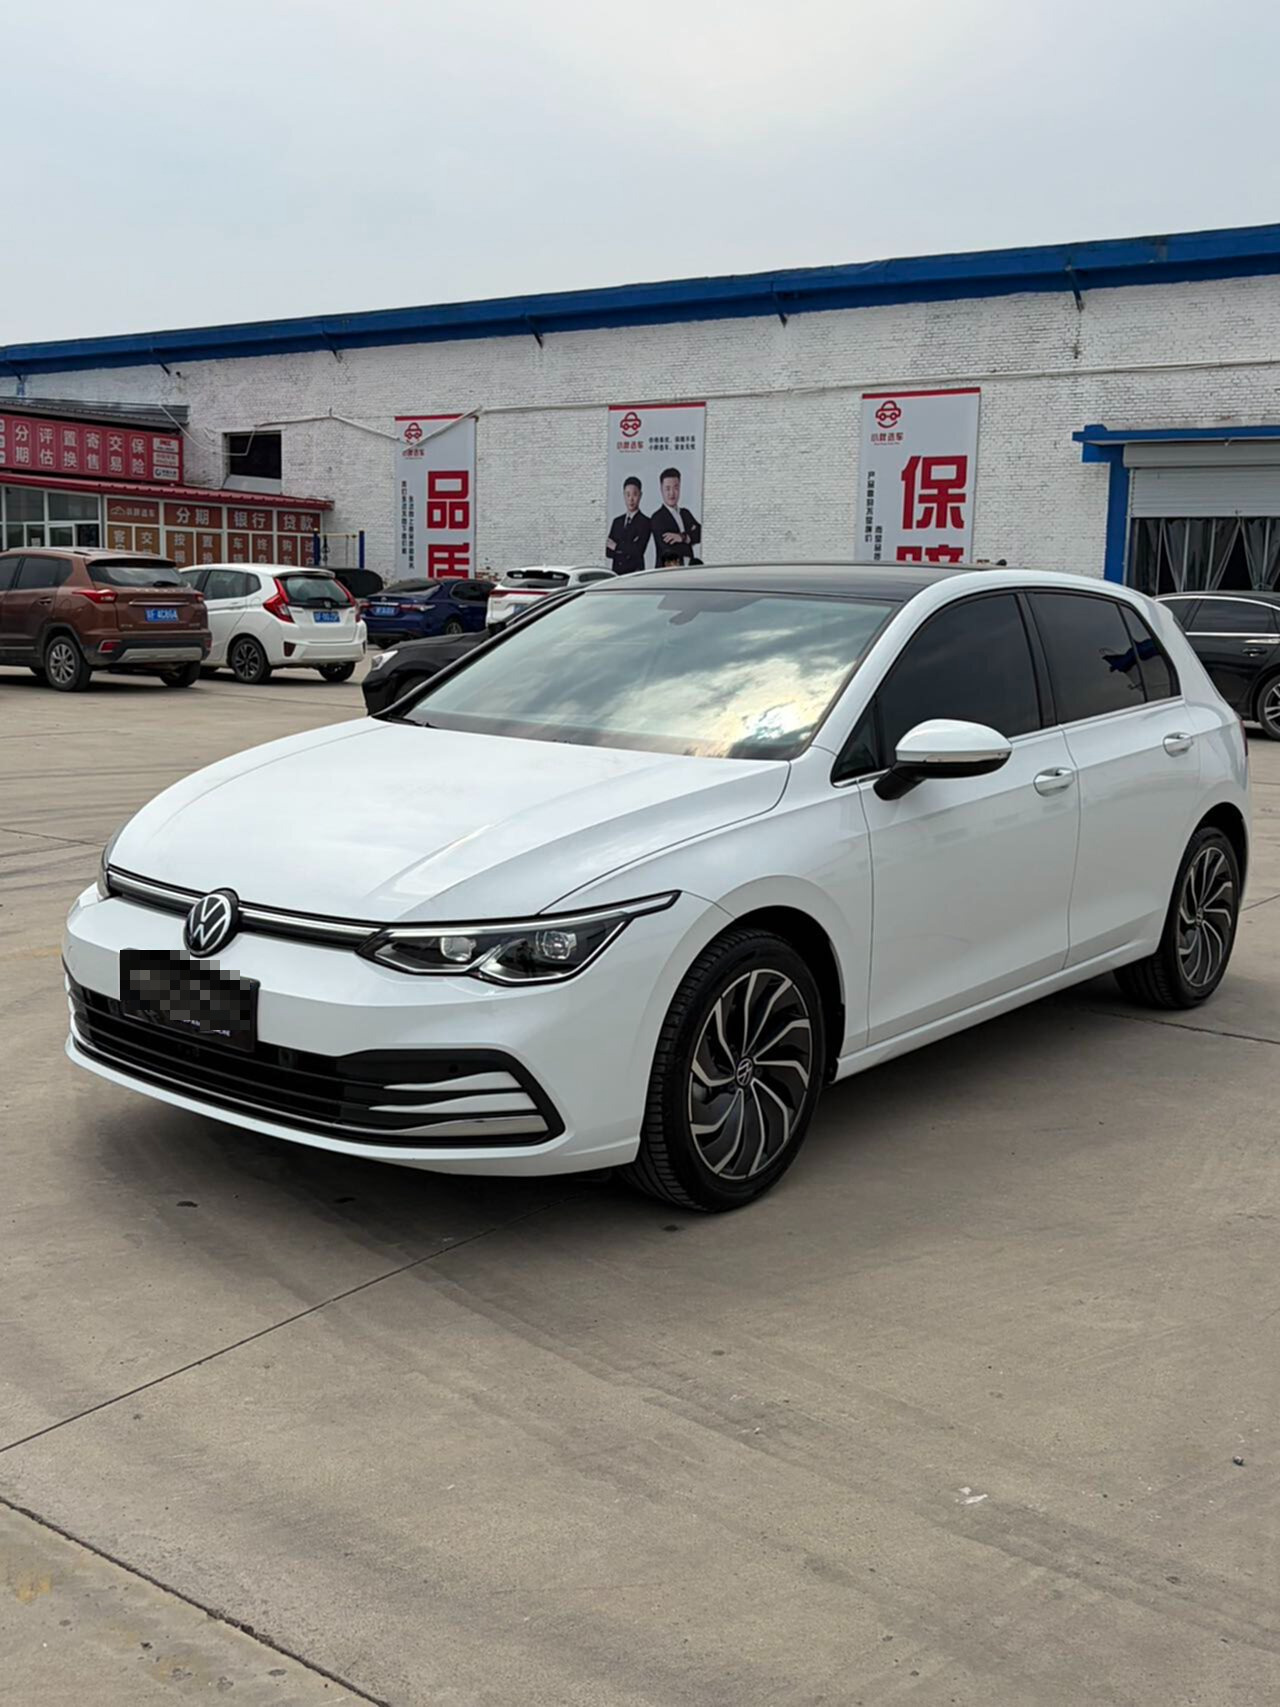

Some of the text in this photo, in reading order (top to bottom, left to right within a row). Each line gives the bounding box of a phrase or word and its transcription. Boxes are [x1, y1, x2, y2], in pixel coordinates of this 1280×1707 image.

[15, 424, 29, 463] 分期
[39, 427, 53, 466] 评估
[63, 430, 78, 468] 置换
[86, 432, 100, 470] 寄售
[109, 435, 124, 472] 交易
[131, 438, 145, 475] 保险
[176, 506, 210, 525] 分期
[233, 511, 266, 528] 银行
[283, 514, 314, 531] 贷款
